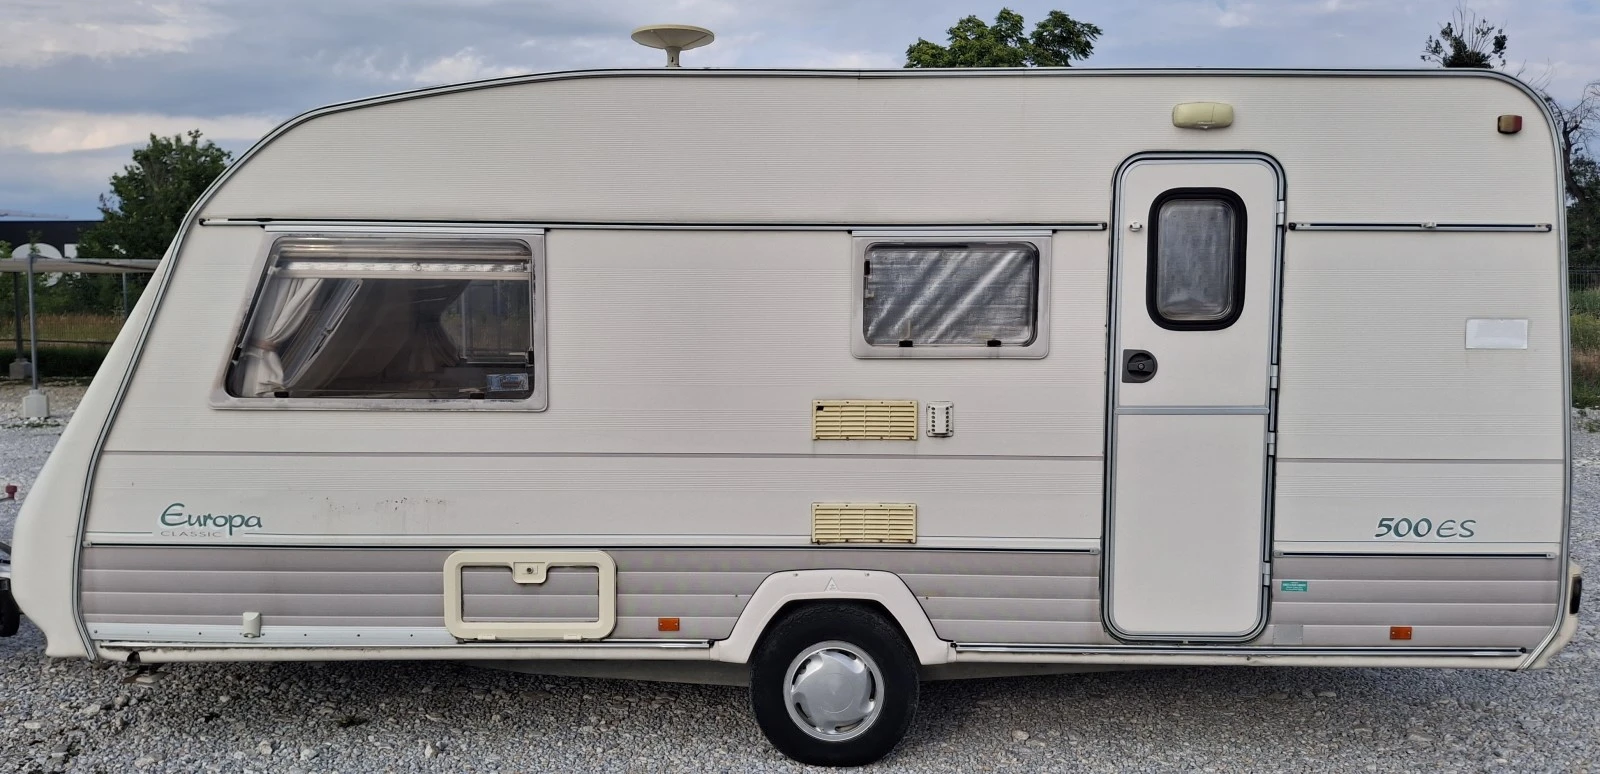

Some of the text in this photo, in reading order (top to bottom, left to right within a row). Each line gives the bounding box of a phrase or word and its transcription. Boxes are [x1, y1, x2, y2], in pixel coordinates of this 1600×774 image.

[160, 502, 262, 536] Europa
[1374, 517, 1477, 538] 500 ES
